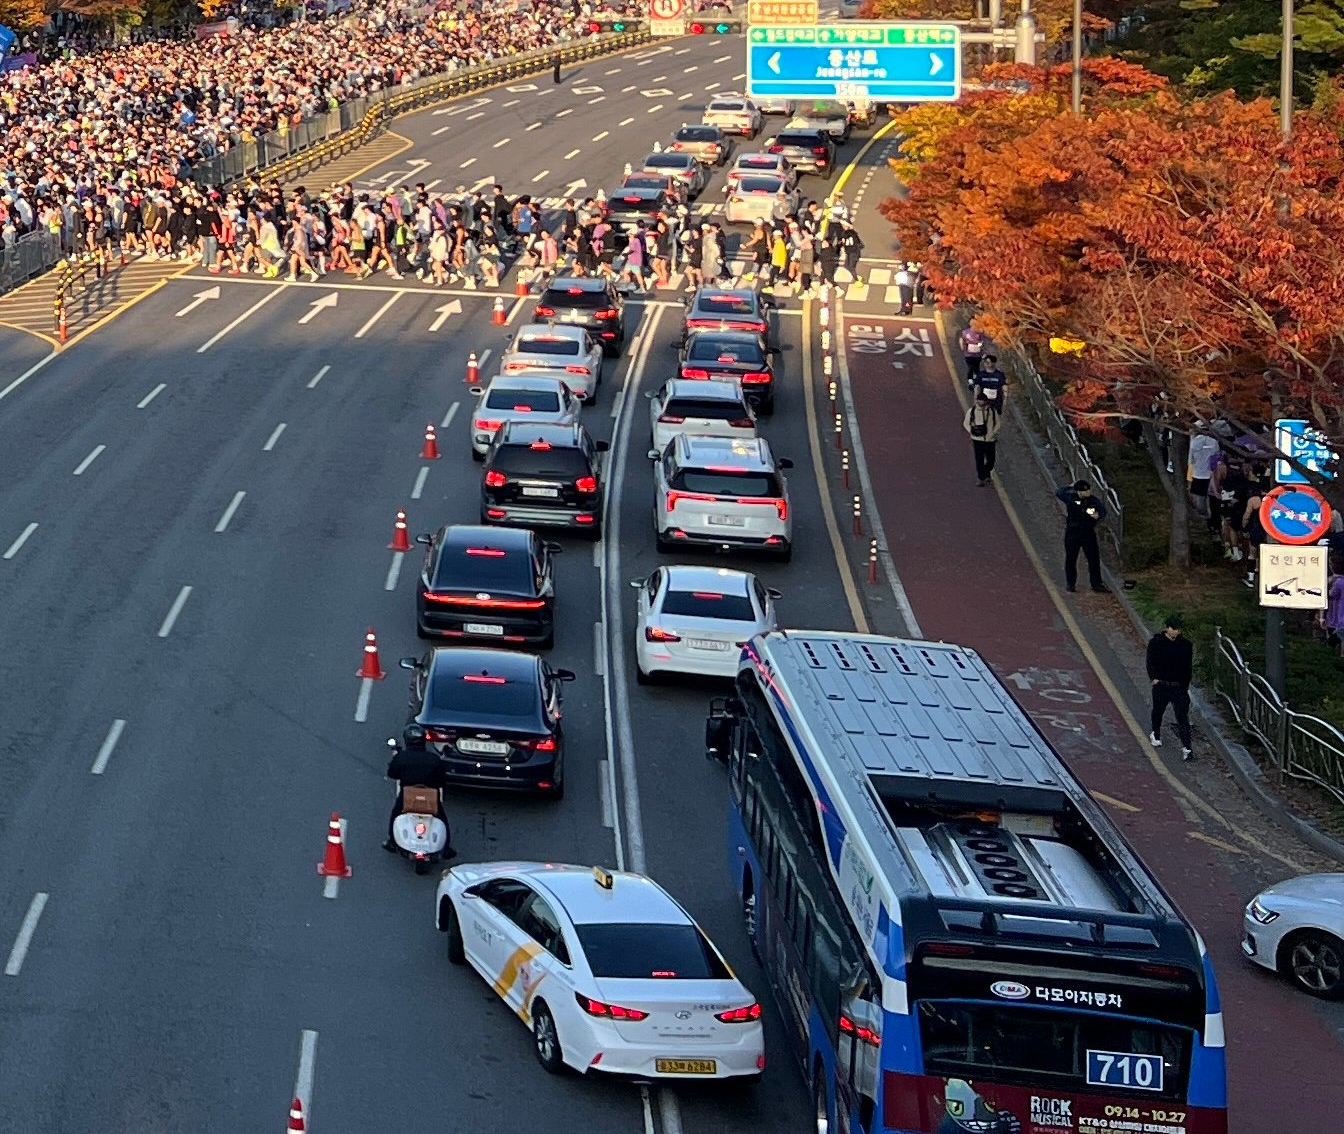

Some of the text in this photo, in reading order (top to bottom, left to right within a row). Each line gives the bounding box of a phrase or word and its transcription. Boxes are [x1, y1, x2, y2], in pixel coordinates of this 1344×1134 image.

[1270, 555, 1320, 567] 견인지역
[1035, 986, 1123, 1008] 다모아자동차
[1096, 1053, 1154, 1087] 710
[1030, 1095, 1072, 1116] ROCK
[1104, 1105, 1140, 1119] 09.14
[1151, 1109, 1186, 1123] 10.27
[1030, 1112, 1074, 1128] MUSICAL
[1078, 1116, 1108, 1128] KT&G
